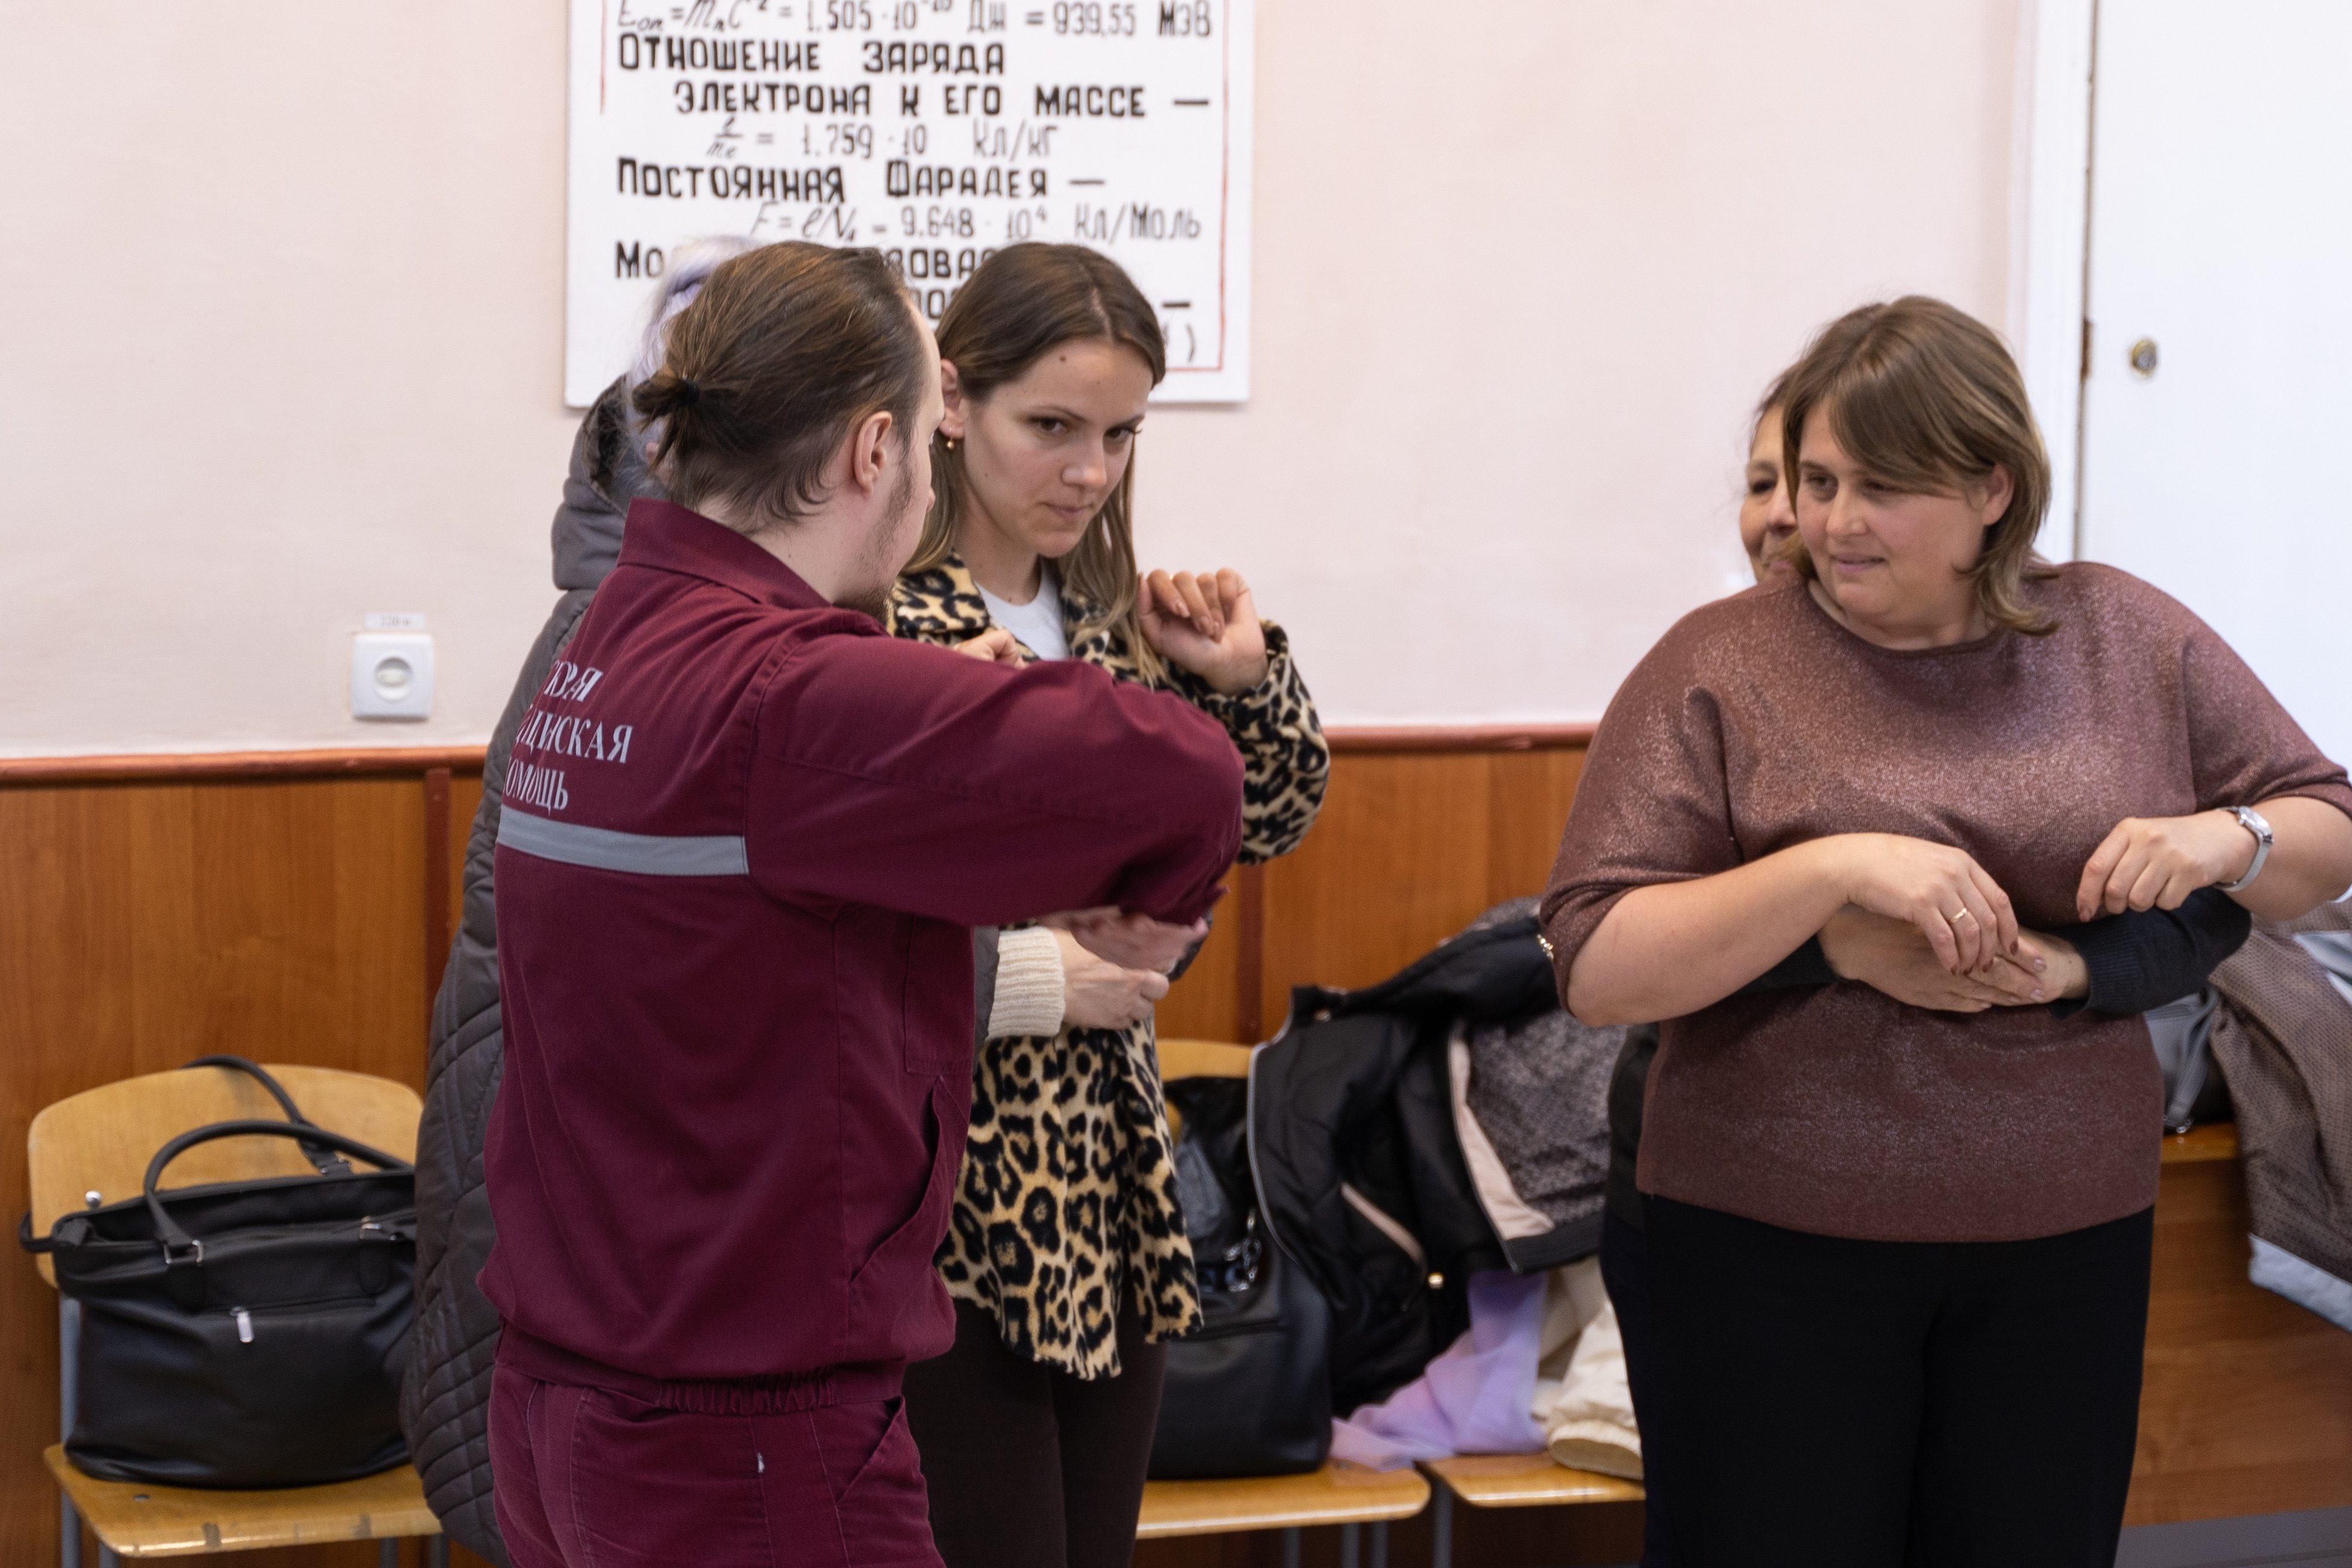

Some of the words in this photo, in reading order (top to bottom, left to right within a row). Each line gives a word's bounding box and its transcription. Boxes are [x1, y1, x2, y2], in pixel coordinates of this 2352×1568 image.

[618, 32, 820, 71] ОТНОШЕНИЕ
[862, 40, 1005, 75] ЗАРЯДА
[673, 79, 872, 116] ЭЛЕКТРОНА
[943, 83, 1003, 117] ЕГО
[1034, 84, 1146, 119] МАССЕ
[617, 156, 846, 204] ПОСТОЯННАЯ
[885, 158, 1048, 198] ФАРАДЕЯ
[503, 755, 568, 816] ОМОЩЬ
